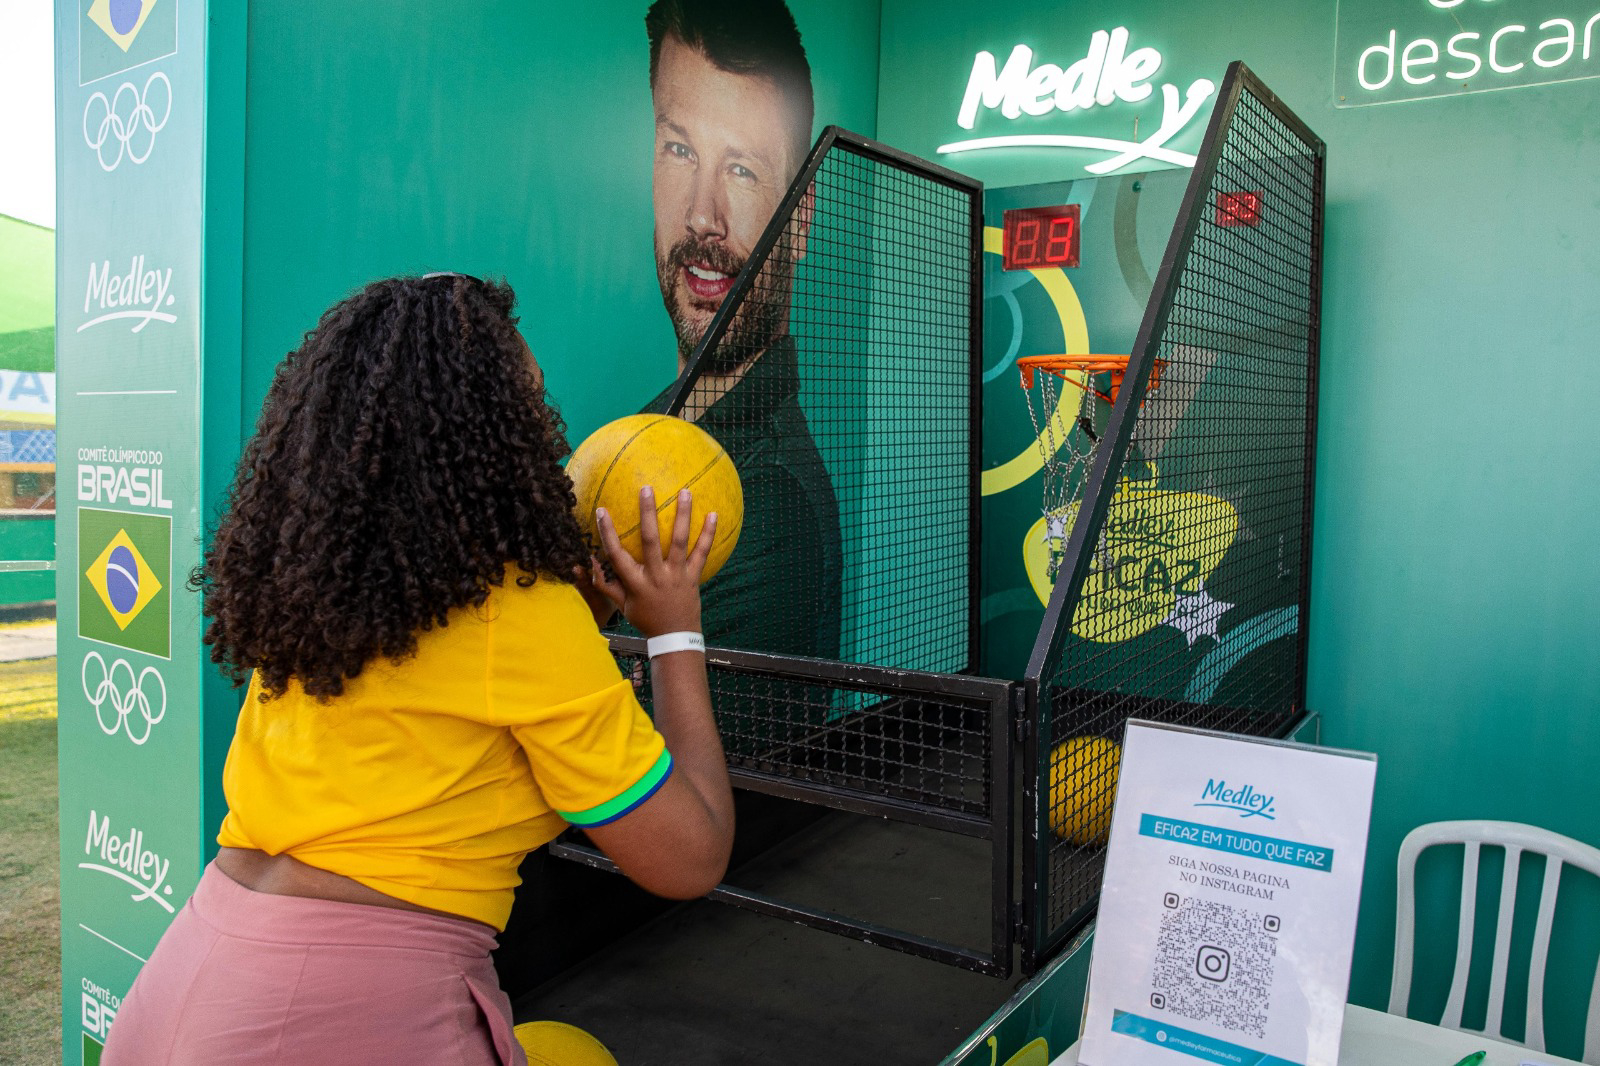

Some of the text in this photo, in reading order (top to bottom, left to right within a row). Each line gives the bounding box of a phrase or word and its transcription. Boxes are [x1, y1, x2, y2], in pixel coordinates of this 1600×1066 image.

[957, 26, 1215, 174] Medley
[78, 445, 163, 465] COMITÊ OLÍMPICO DO
[78, 464, 172, 509] BRASIL
[1153, 821, 1326, 867] EFICAZ EM TUDO QUE FAZ
[1168, 854, 1291, 890] SIGA NOSSA PAGINA
[1179, 871, 1275, 901] NO INSTAGRAM
[82, 977, 111, 1005] COMITÊ
